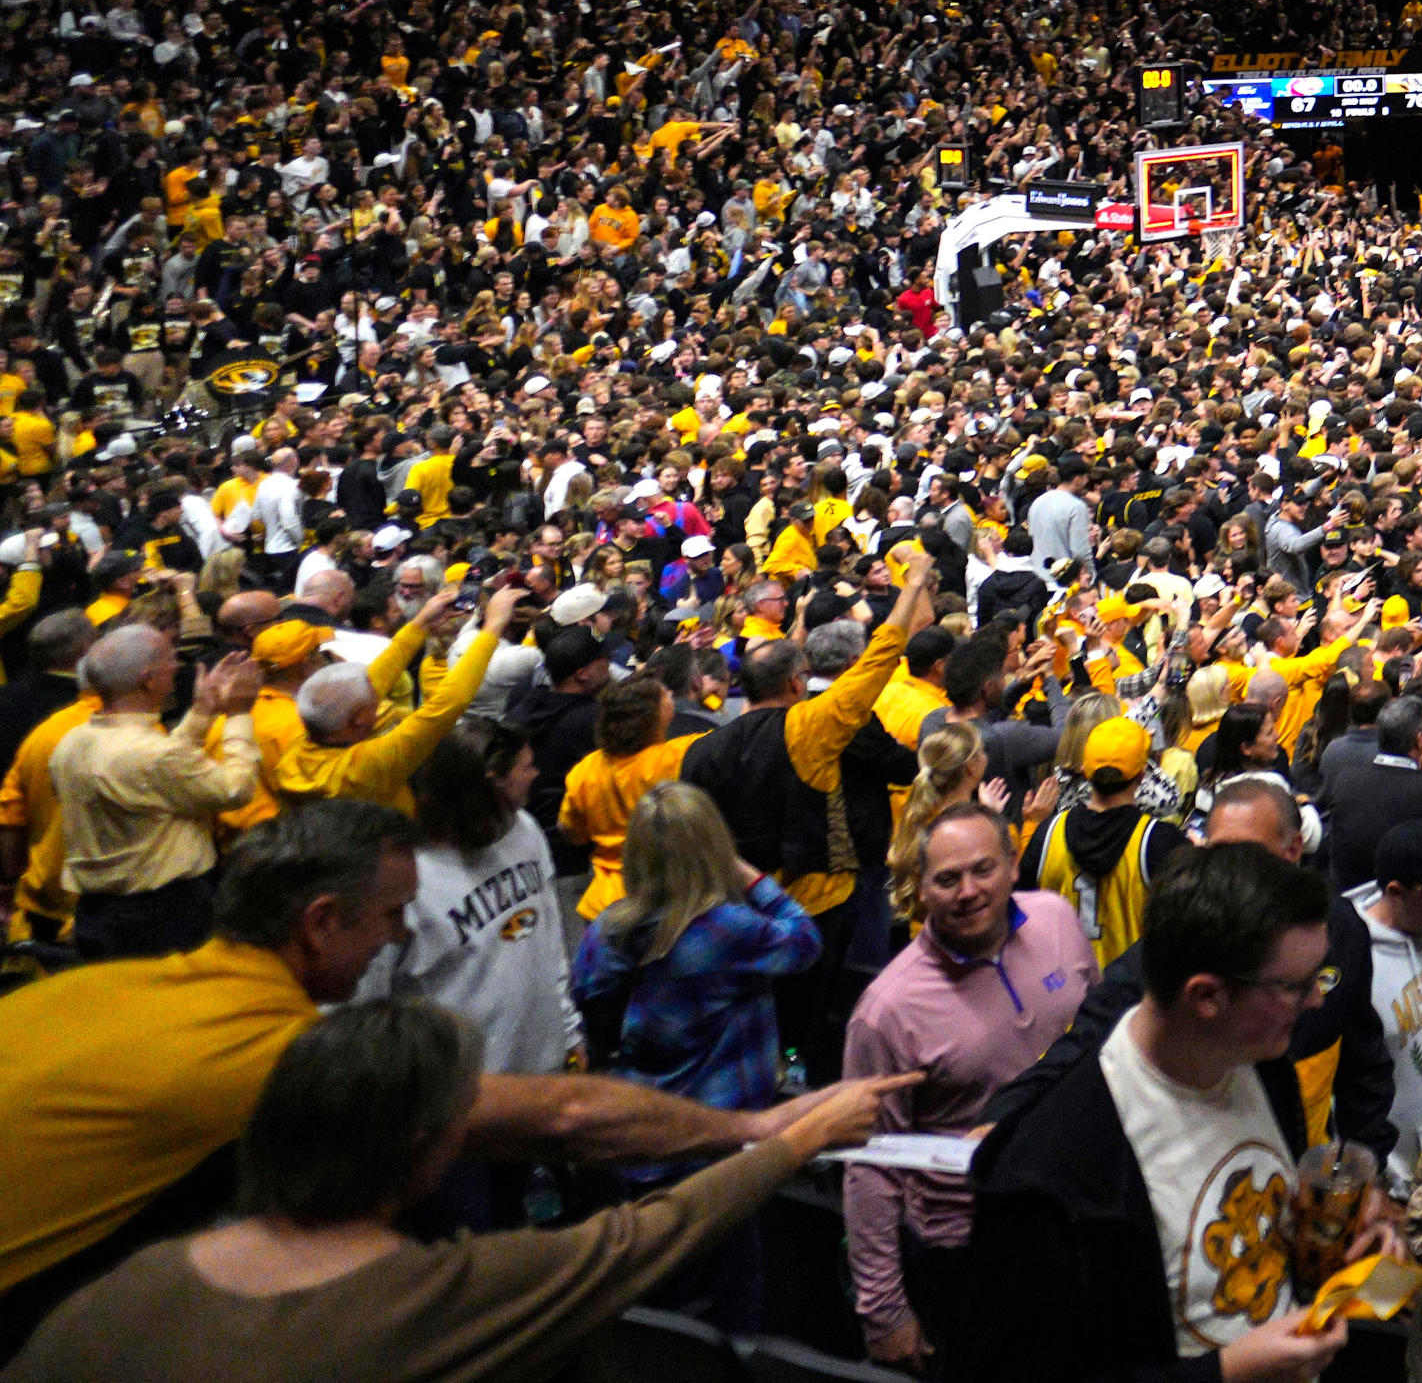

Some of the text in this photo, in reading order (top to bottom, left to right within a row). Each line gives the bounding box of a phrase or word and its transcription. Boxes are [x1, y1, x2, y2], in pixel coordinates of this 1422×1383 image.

[1342, 79, 1378, 93] 00.0
[1291, 97, 1316, 113] 67
[1073, 870, 1103, 940] 1
